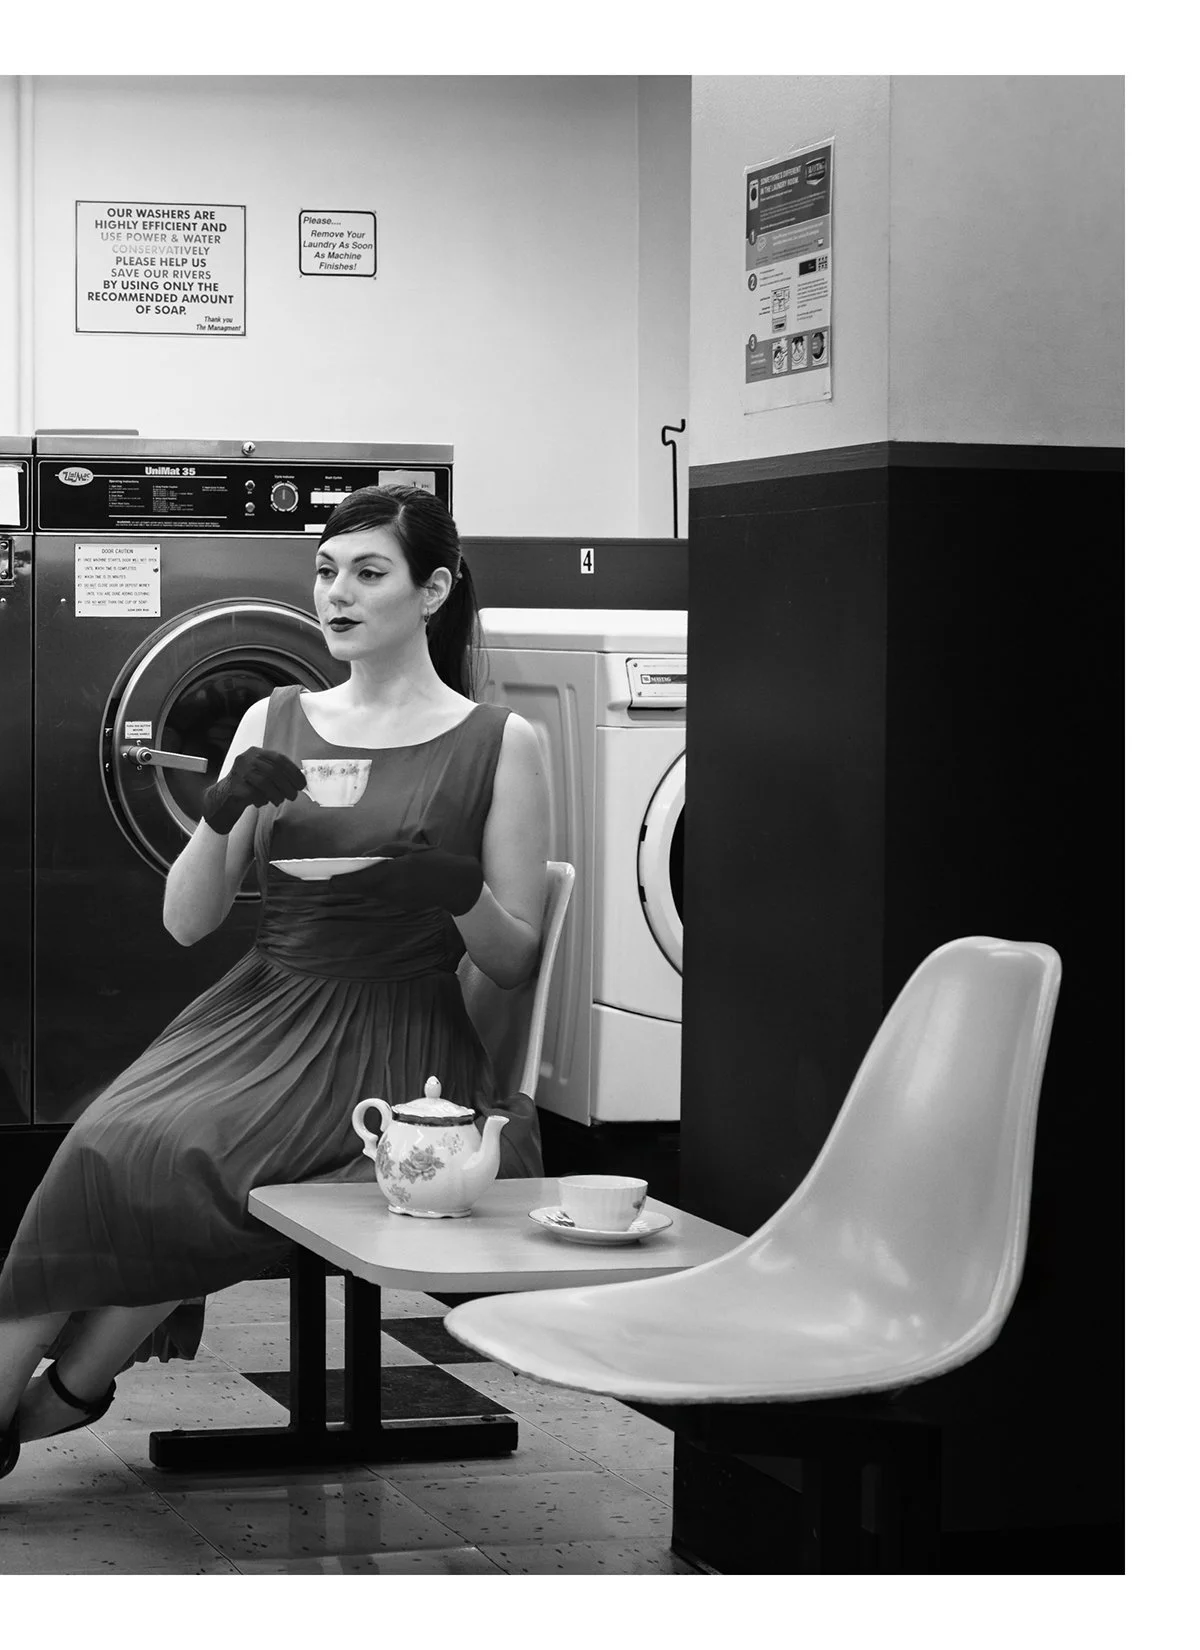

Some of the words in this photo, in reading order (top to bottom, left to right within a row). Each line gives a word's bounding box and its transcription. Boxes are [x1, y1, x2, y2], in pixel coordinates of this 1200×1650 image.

[107, 208, 132, 218] OUR
[135, 208, 190, 218] WASHERS
[194, 209, 216, 219] ARE
[95, 220, 138, 230] HIGHLY
[142, 221, 198, 231] EFFICIENT
[200, 222, 227, 232] AND
[101, 232, 122, 242] USE
[126, 233, 167, 242] POWER
[171, 234, 179, 243] &
[183, 234, 221, 243] WATER
[311, 230, 344, 238] Remove
[347, 230, 365, 239] Your
[112, 244, 210, 256] CONSERVATIVELY
[303, 241, 337, 250] Laundry
[314, 251, 325, 259] As
[328, 251, 362, 260] Machine
[115, 256, 156, 266] PLEASE
[159, 257, 188, 267] HELP
[192, 258, 207, 267] US
[319, 262, 357, 270] Finishes!
[111, 268, 140, 278] SAVE
[143, 269, 169, 279] OUR
[173, 270, 212, 279] RIVERS
[103, 280, 117, 290] BY
[121, 280, 159, 290] USING
[163, 281, 194, 291] ONLY
[197, 282, 219, 291] THE
[87, 292, 178, 302] RECOMMENDED
[181, 294, 234, 304] AMOUNT
[135, 305, 151, 314] OF
[155, 305, 187, 315] SOAP.
[145, 466, 181, 475] UniMat
[182, 467, 196, 476] 35
[583, 550, 592, 571] 4
